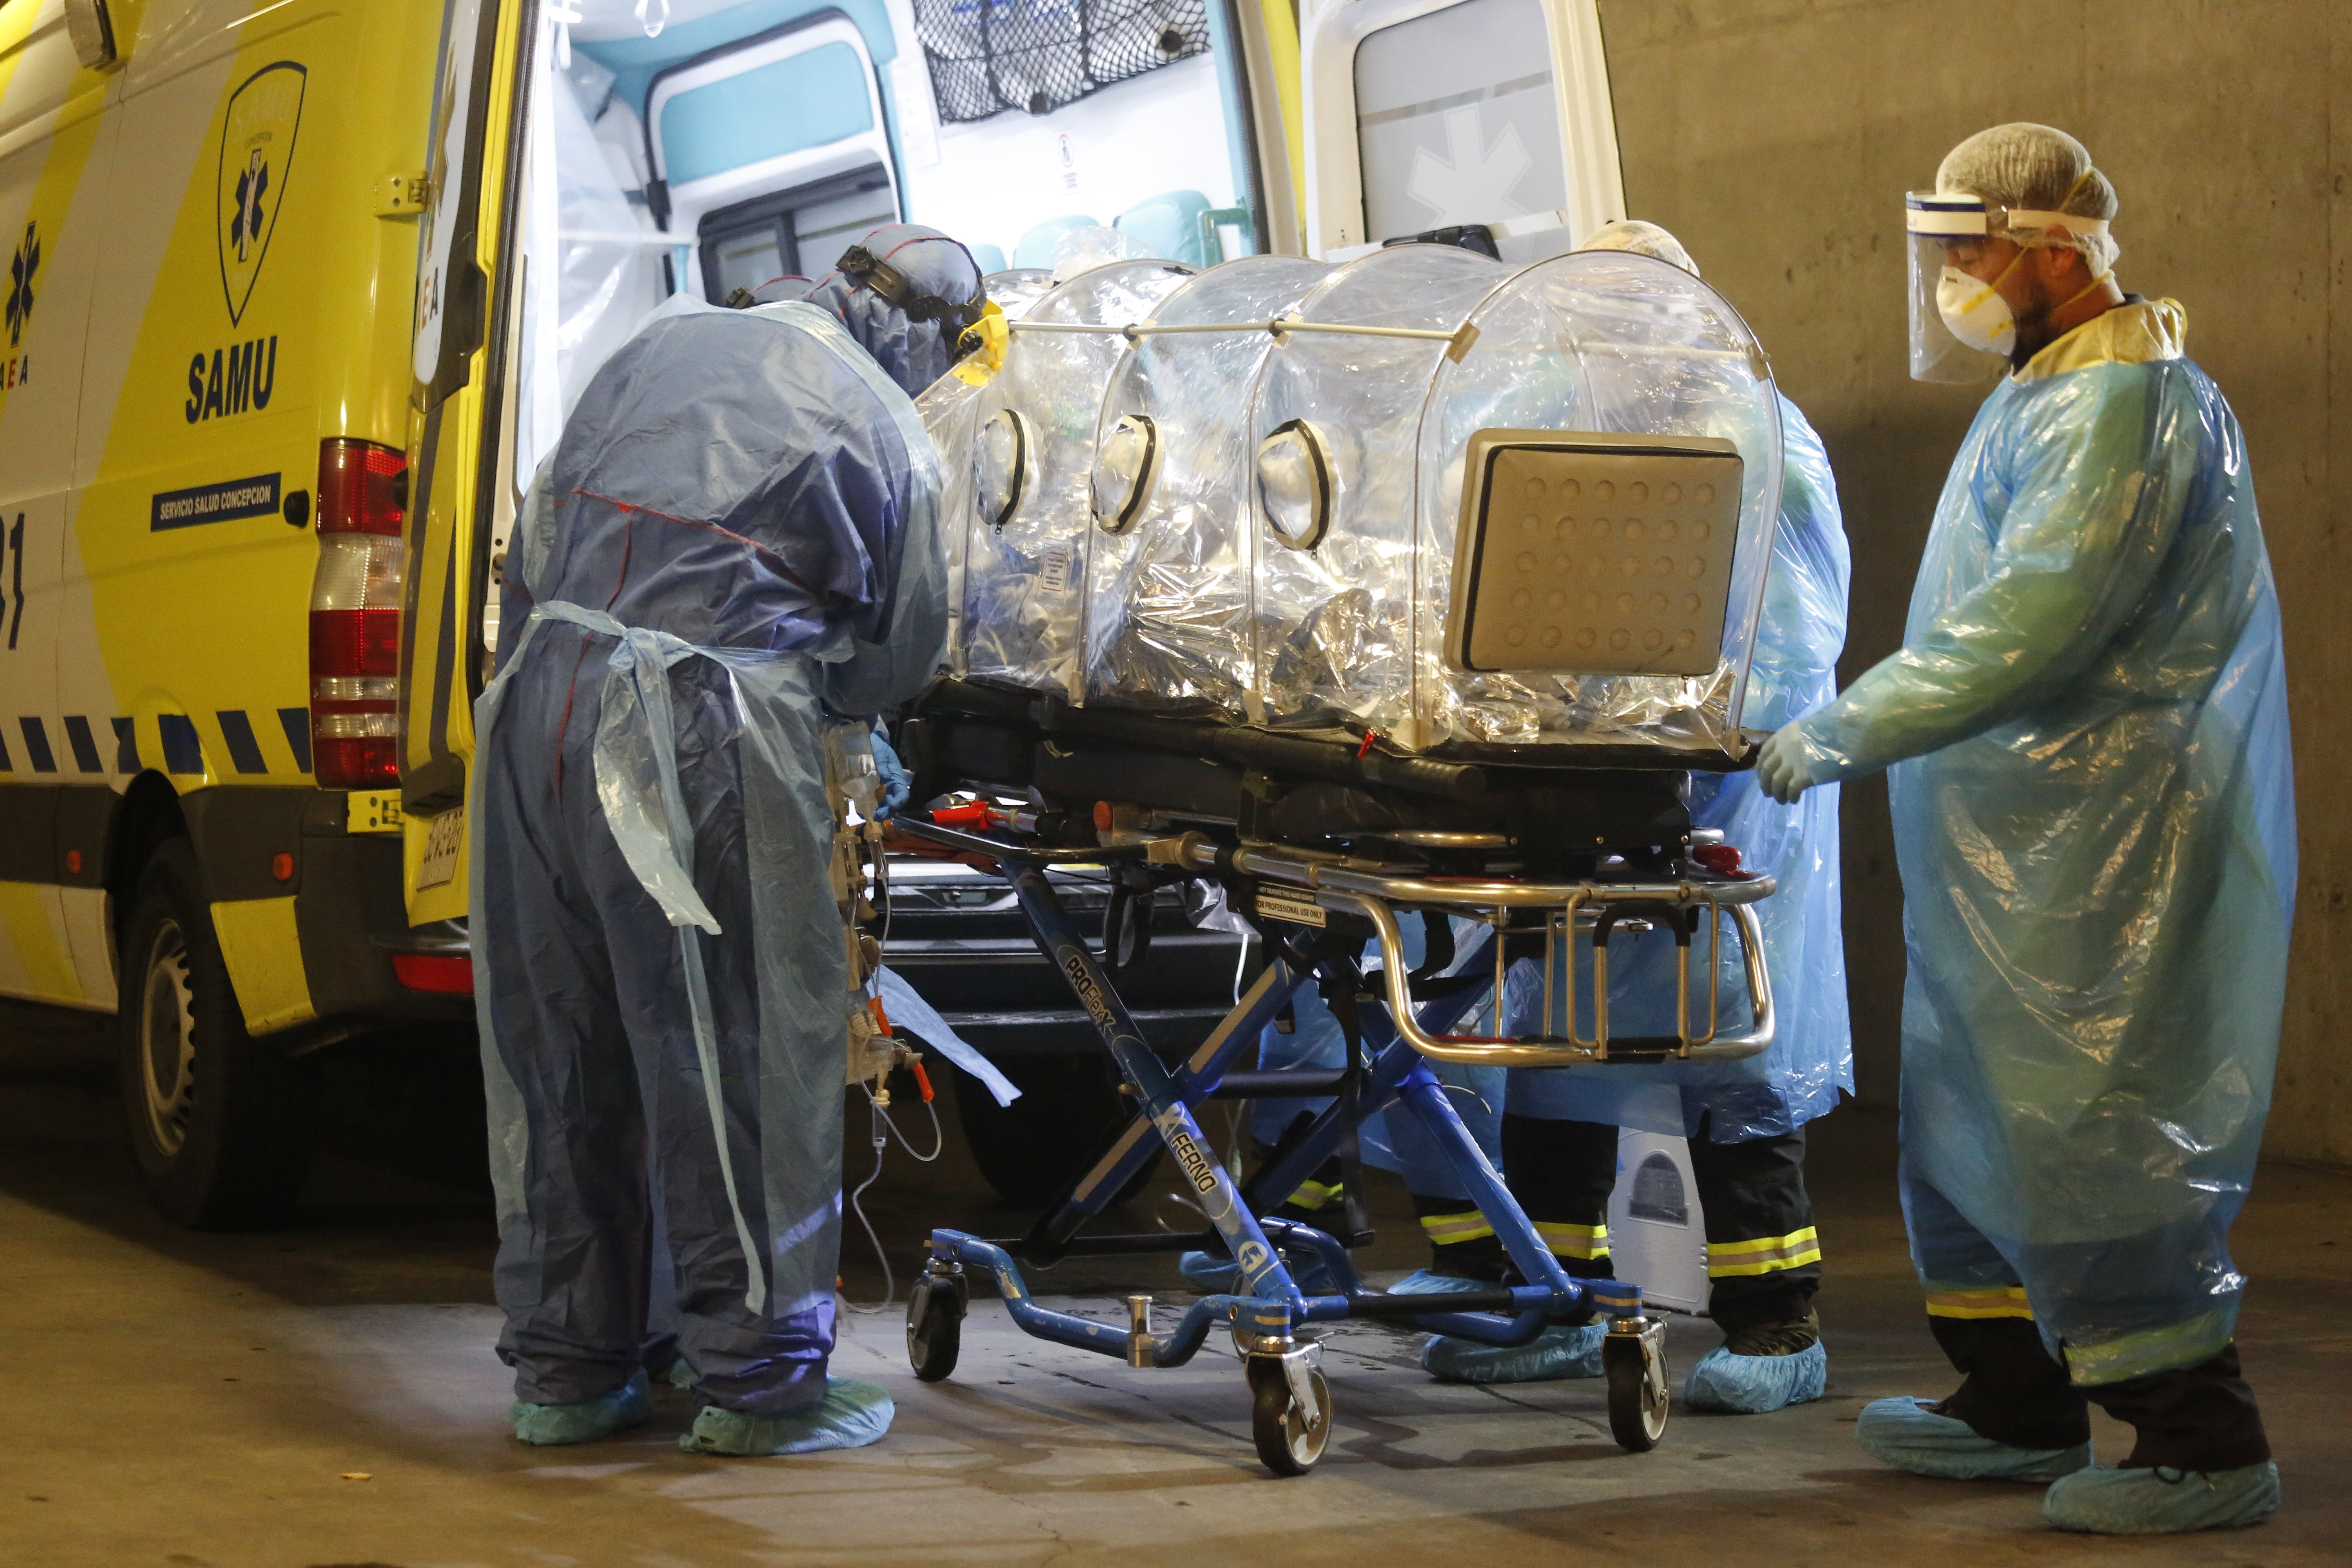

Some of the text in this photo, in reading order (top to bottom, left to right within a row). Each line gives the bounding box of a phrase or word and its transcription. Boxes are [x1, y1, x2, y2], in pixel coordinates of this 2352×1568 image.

[186, 335, 278, 424] SAMU
[160, 484, 271, 521] SERVICIO SALUD CONCEPCION
[1265, 901, 1299, 915] PROFESSIONAL
[1301, 909, 1309, 917] USE
[1310, 910, 1323, 919] ONLY
[1171, 1133, 1217, 1192] FERNO
